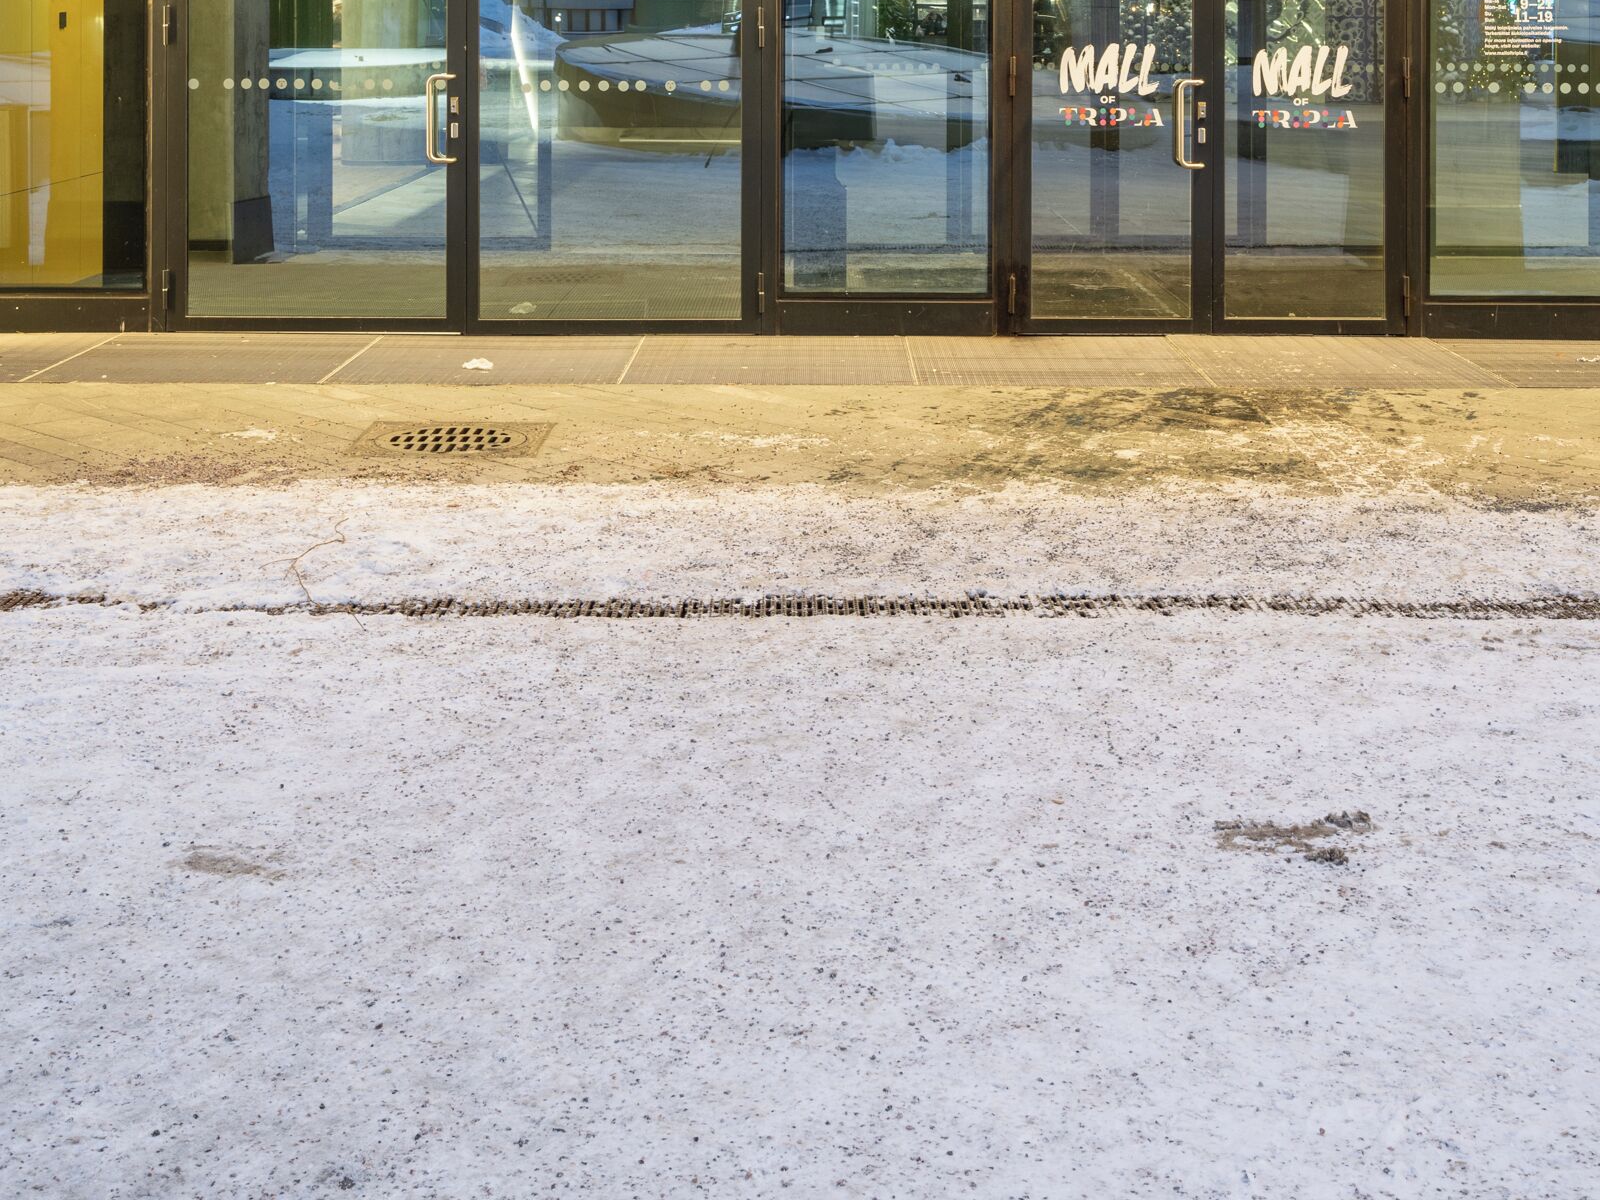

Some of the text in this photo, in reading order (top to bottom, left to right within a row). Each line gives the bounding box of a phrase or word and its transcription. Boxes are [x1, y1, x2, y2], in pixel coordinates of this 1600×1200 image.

[1059, 43, 1160, 97] MALL
[1252, 45, 1353, 98] MALL
[1100, 96, 1116, 104] OF
[1293, 98, 1309, 106] OF
[1059, 107, 1165, 127] TRIPLA
[1252, 109, 1358, 130] TRIPLA
